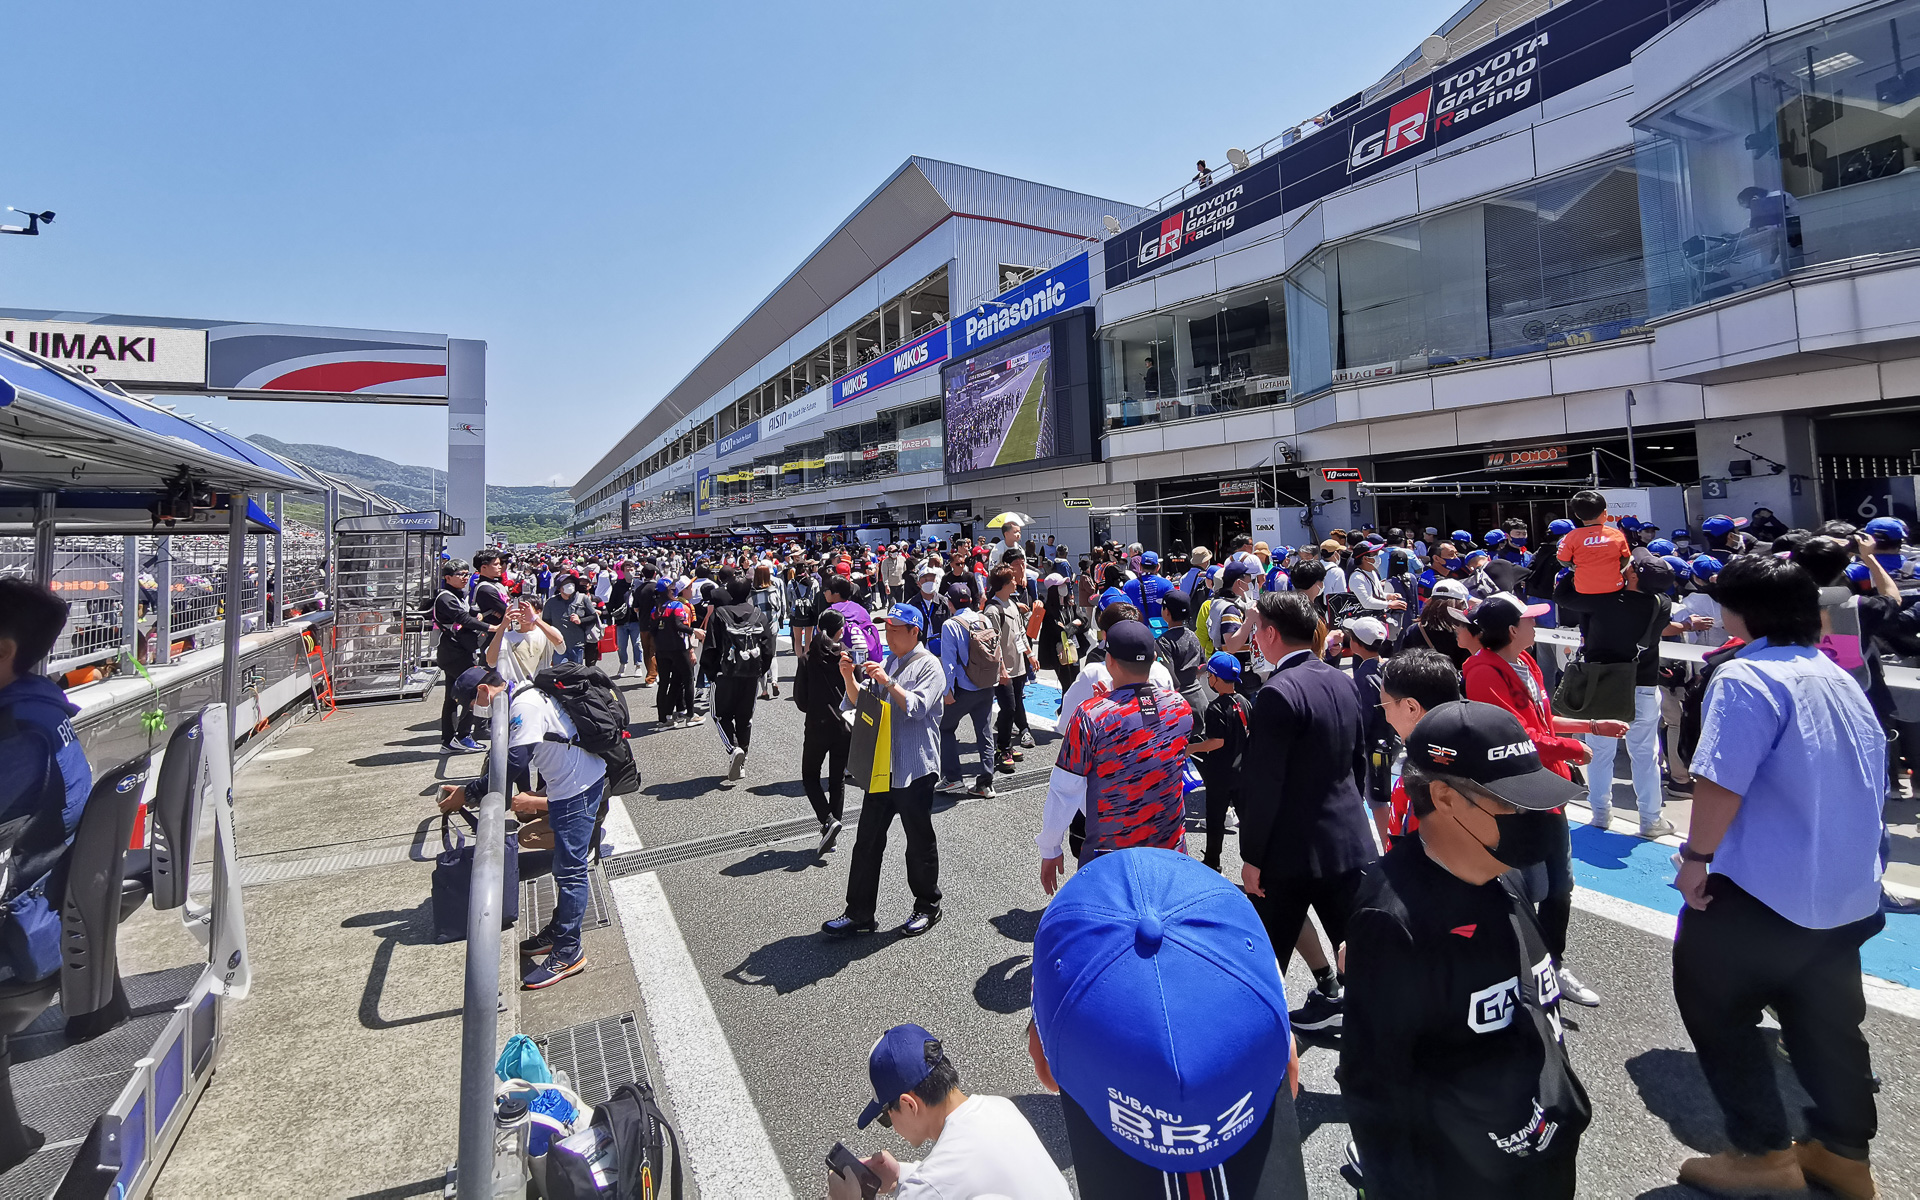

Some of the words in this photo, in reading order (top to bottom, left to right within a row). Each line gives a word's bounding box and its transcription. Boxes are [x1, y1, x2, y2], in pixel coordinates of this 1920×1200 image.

[1438, 31, 1550, 96] TOYOTA
[1435, 57, 1537, 115] GAZOO
[1434, 77, 1532, 133] Racing
[1351, 112, 1425, 168] GR
[1185, 200, 1238, 232] GAZOO
[1187, 184, 1244, 219] TOYOTA
[1140, 228, 1181, 263] GR
[1184, 215, 1235, 245] Racing
[965, 278, 1066, 347] Panasonic
[768, 411, 787, 432] AISIN
[720, 438, 733, 453] AISIN
[1487, 452, 1505, 466] 10
[1510, 448, 1558, 463] PONOS
[1327, 470, 1337, 479] 10
[1708, 481, 1721, 496] 3
[1793, 477, 1800, 493] 2
[1313, 505, 1321, 513] 4
[1353, 501, 1359, 512] 3
[1857, 494, 1895, 519] 61
[1107, 1087, 1183, 1124] SUBARU
[1108, 1091, 1254, 1146] BRZ
[1111, 1123, 1140, 1145] 2023
[1143, 1139, 1194, 1155] SUBARU
[1198, 1138, 1219, 1153] BRZ
[1222, 1114, 1254, 1142] GT300
